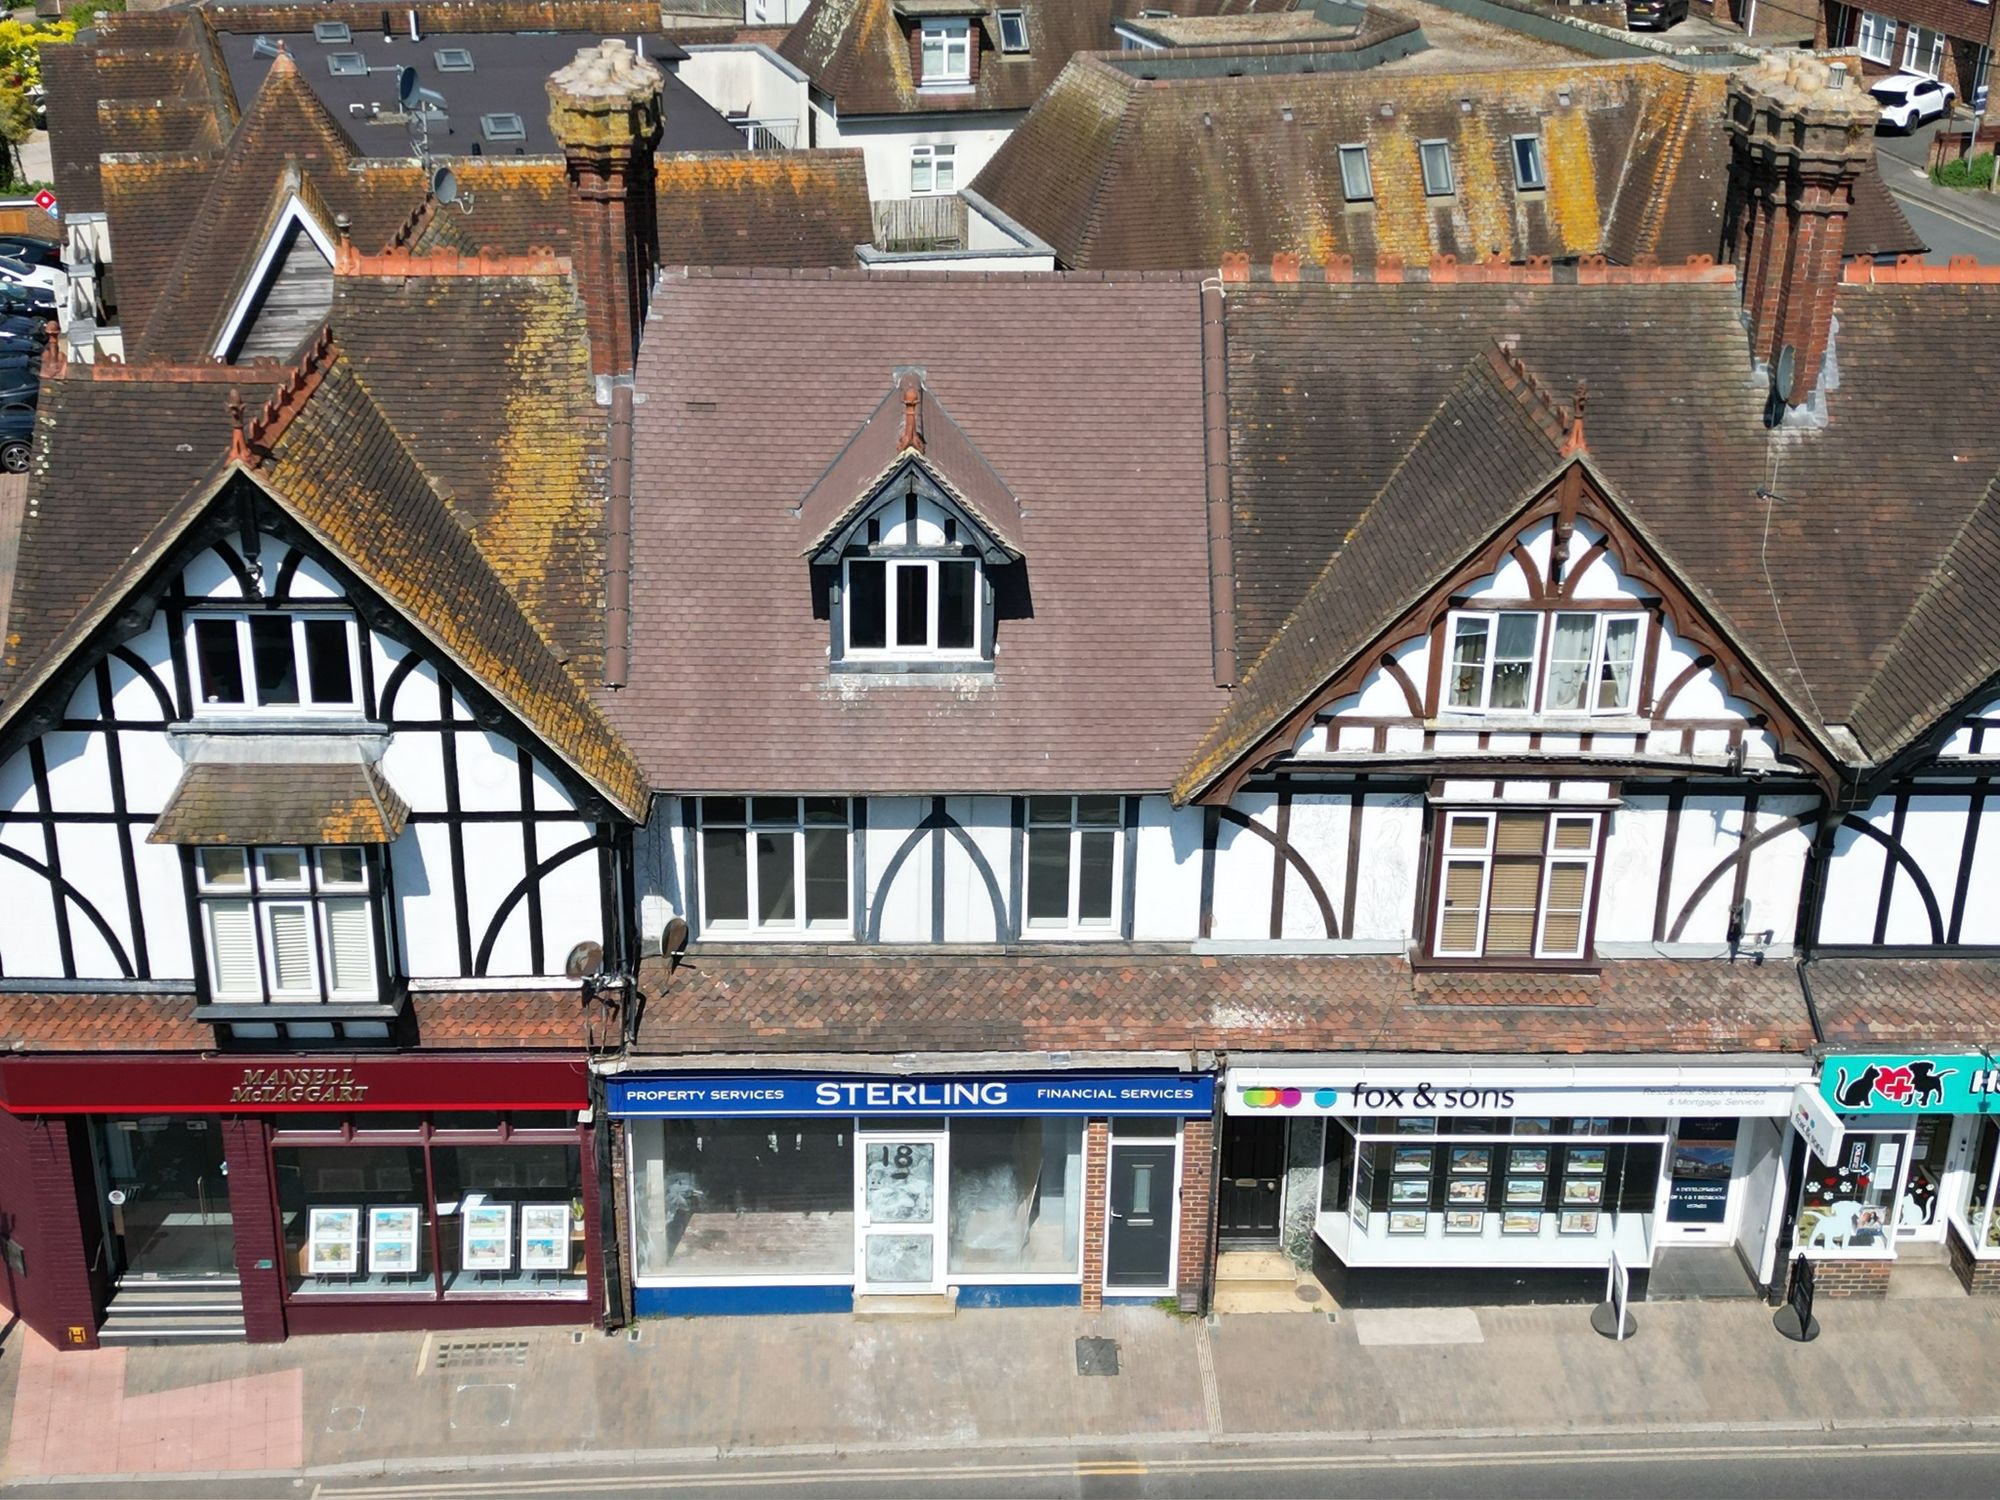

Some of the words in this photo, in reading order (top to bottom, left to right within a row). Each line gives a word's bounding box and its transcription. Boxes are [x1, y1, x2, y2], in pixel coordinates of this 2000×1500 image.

[241, 1068, 356, 1085] MANSELL
[230, 1086, 369, 1102] McTAGGART
[626, 1090, 706, 1101] PROPERTY
[710, 1089, 785, 1100] SERVICES
[815, 1082, 1009, 1106] STERLING
[1037, 1088, 1117, 1099] FINANCIAL
[1120, 1088, 1194, 1099] SERVICES
[1351, 1082, 1405, 1109] fox
[1413, 1082, 1437, 1109] &
[1444, 1087, 1516, 1109] sons
[1678, 1098, 1722, 1107] Mortgage
[1725, 1097, 1765, 1106] Services
[882, 1145, 914, 1169] 18
